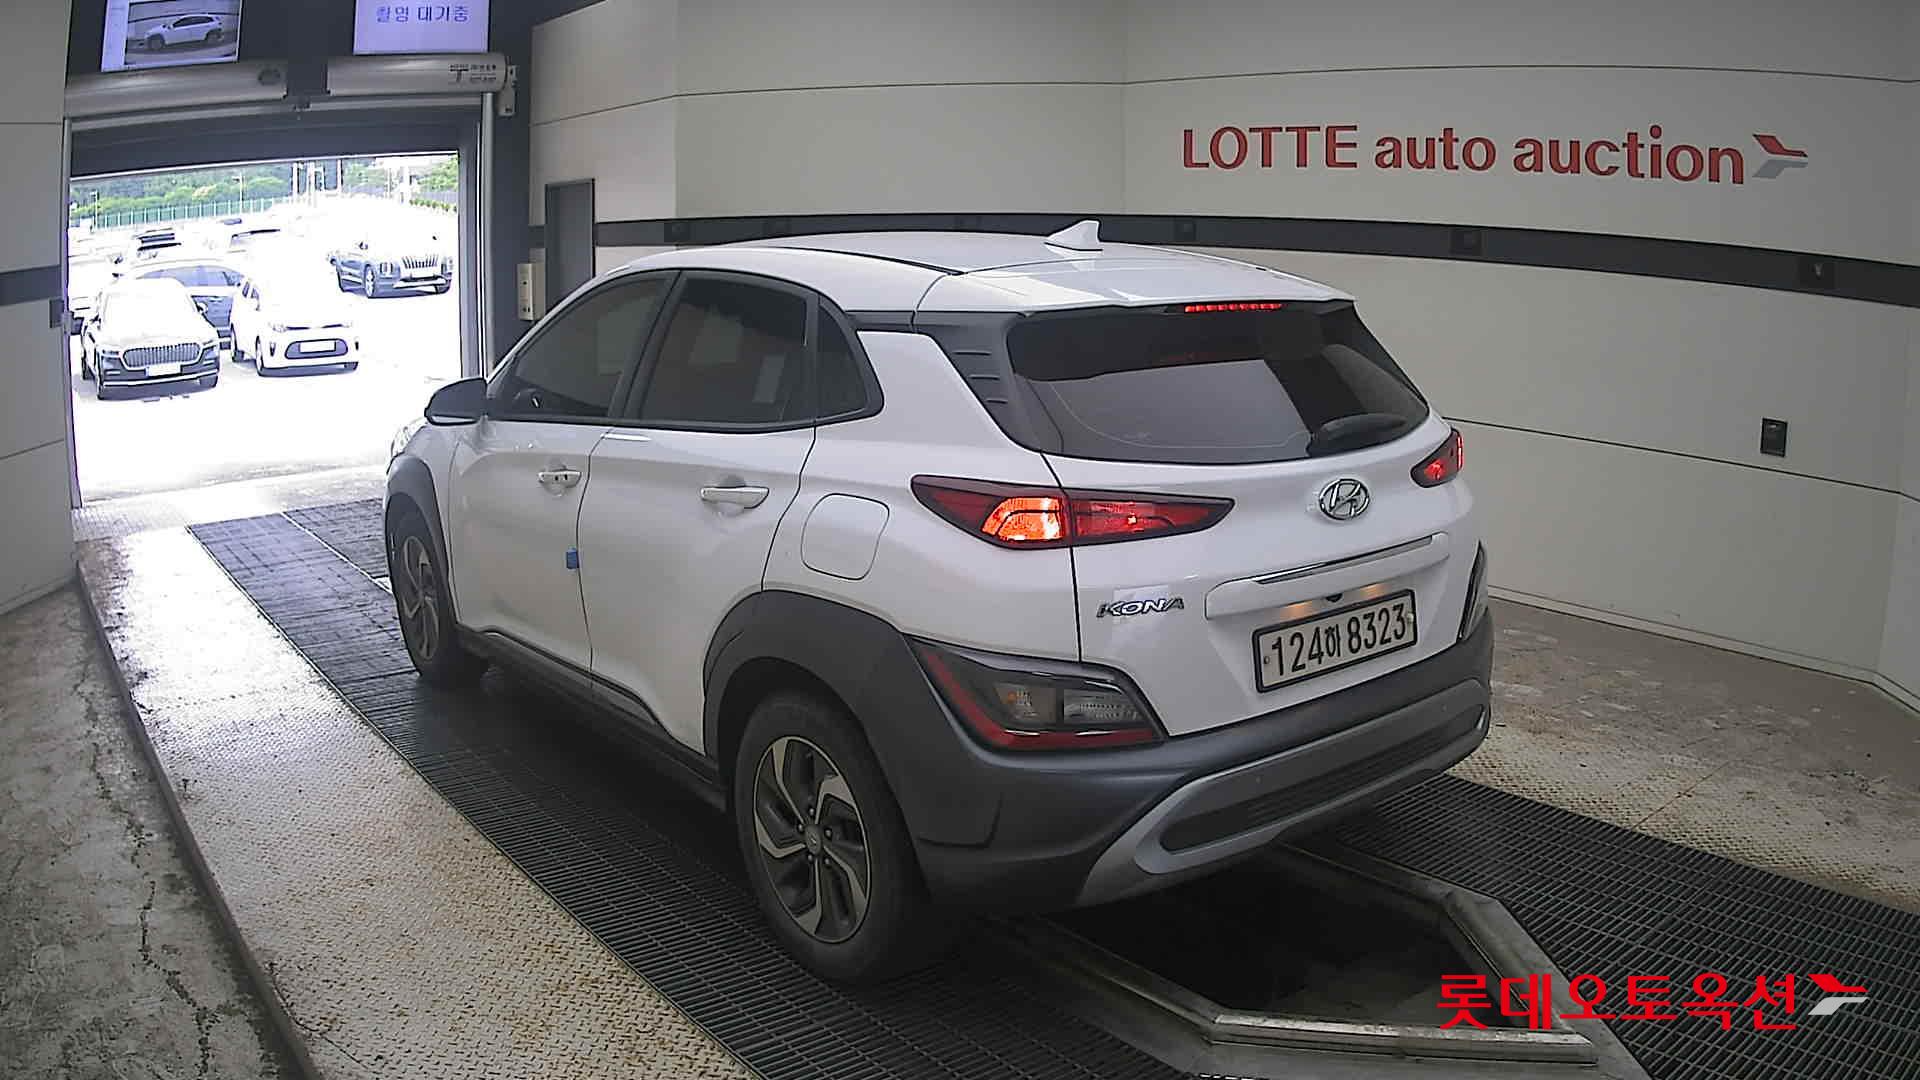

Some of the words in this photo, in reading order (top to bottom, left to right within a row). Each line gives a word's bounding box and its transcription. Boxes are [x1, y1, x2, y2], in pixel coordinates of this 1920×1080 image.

[417, 5, 469, 23] 대기중
[1183, 125, 1359, 169] LOTTE
[1375, 127, 1497, 171] auto
[1513, 124, 1745, 185] auction
[1096, 597, 1184, 618] KONA
[1346, 604, 1407, 655] 8323
